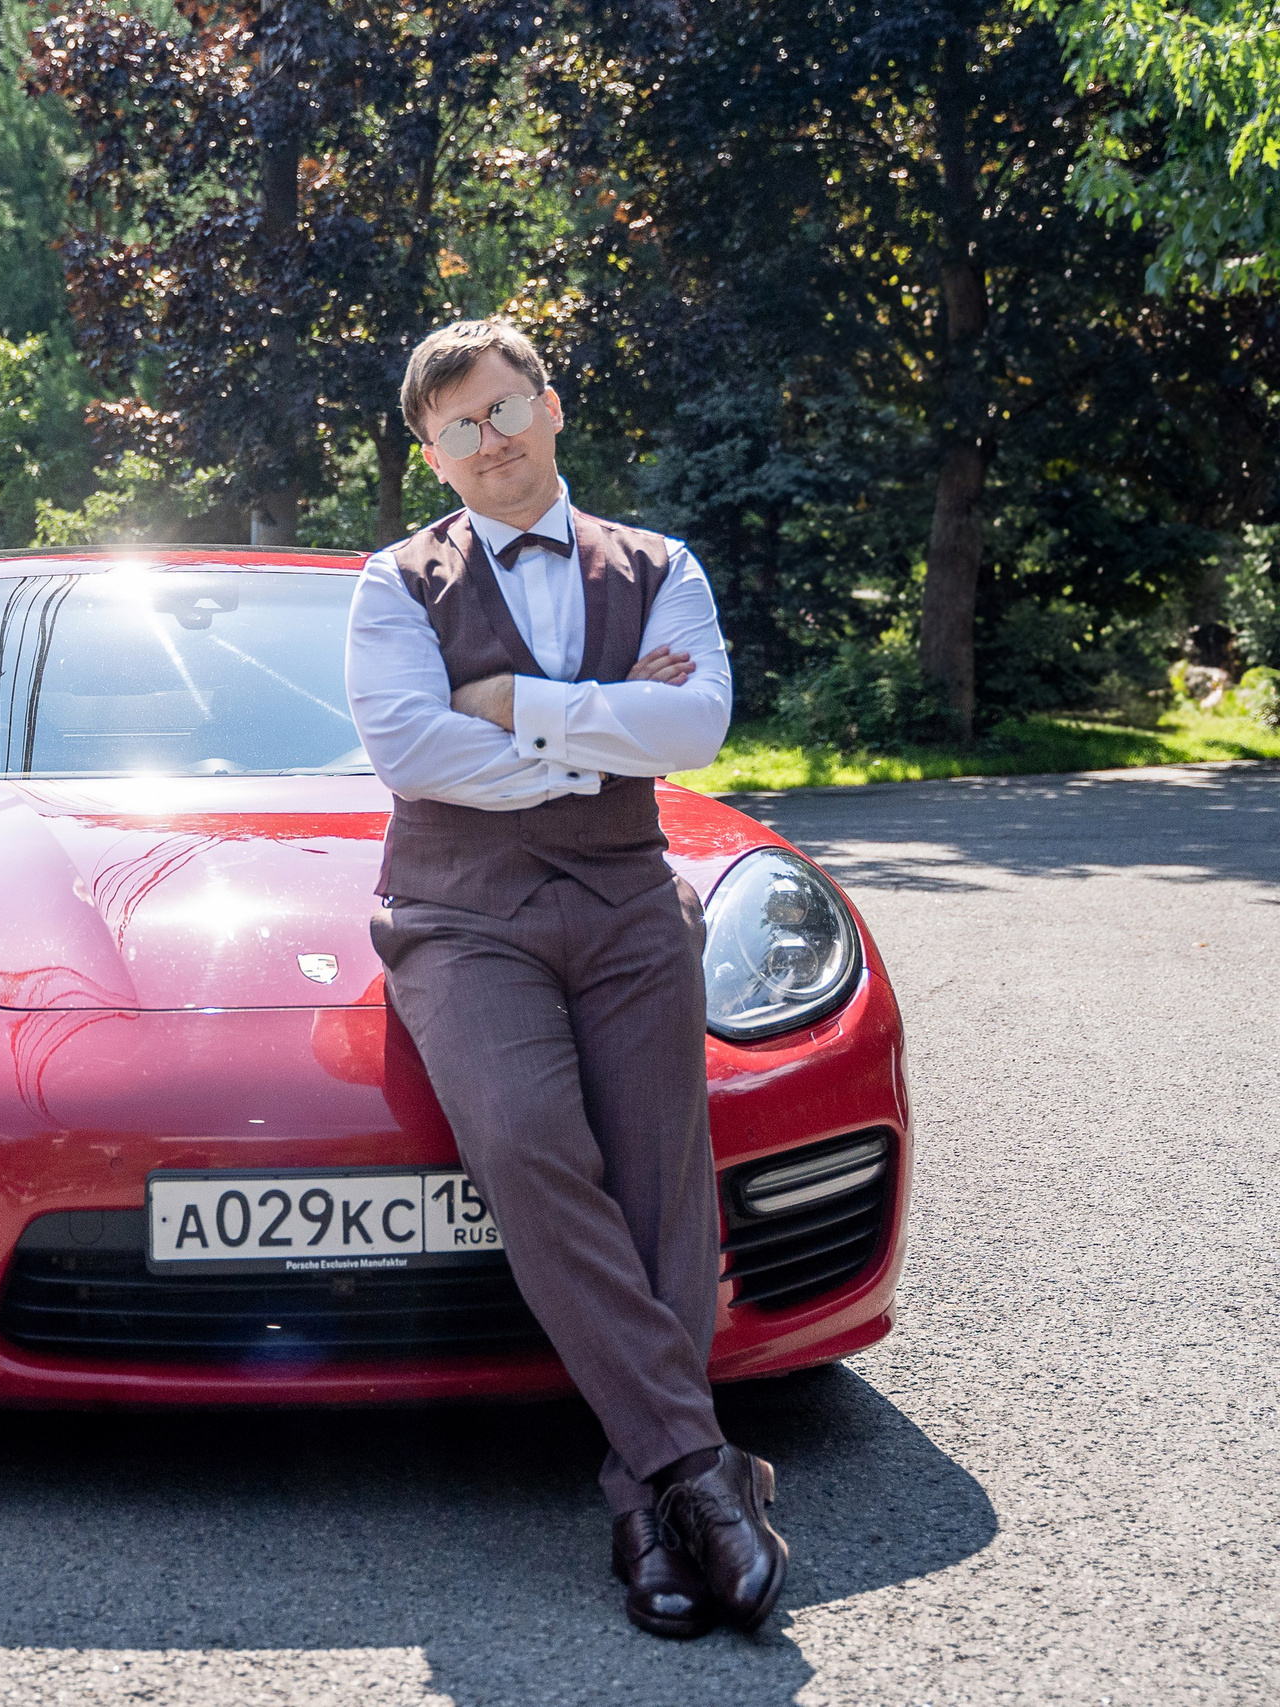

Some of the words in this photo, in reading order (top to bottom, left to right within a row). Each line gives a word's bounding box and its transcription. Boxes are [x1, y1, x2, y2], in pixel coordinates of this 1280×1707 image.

[454, 1227, 498, 1245] RUS
[285, 1260, 320, 1270] Porsche
[320, 1259, 359, 1269] Exclusive
[360, 1258, 407, 1268] Manufaktur
